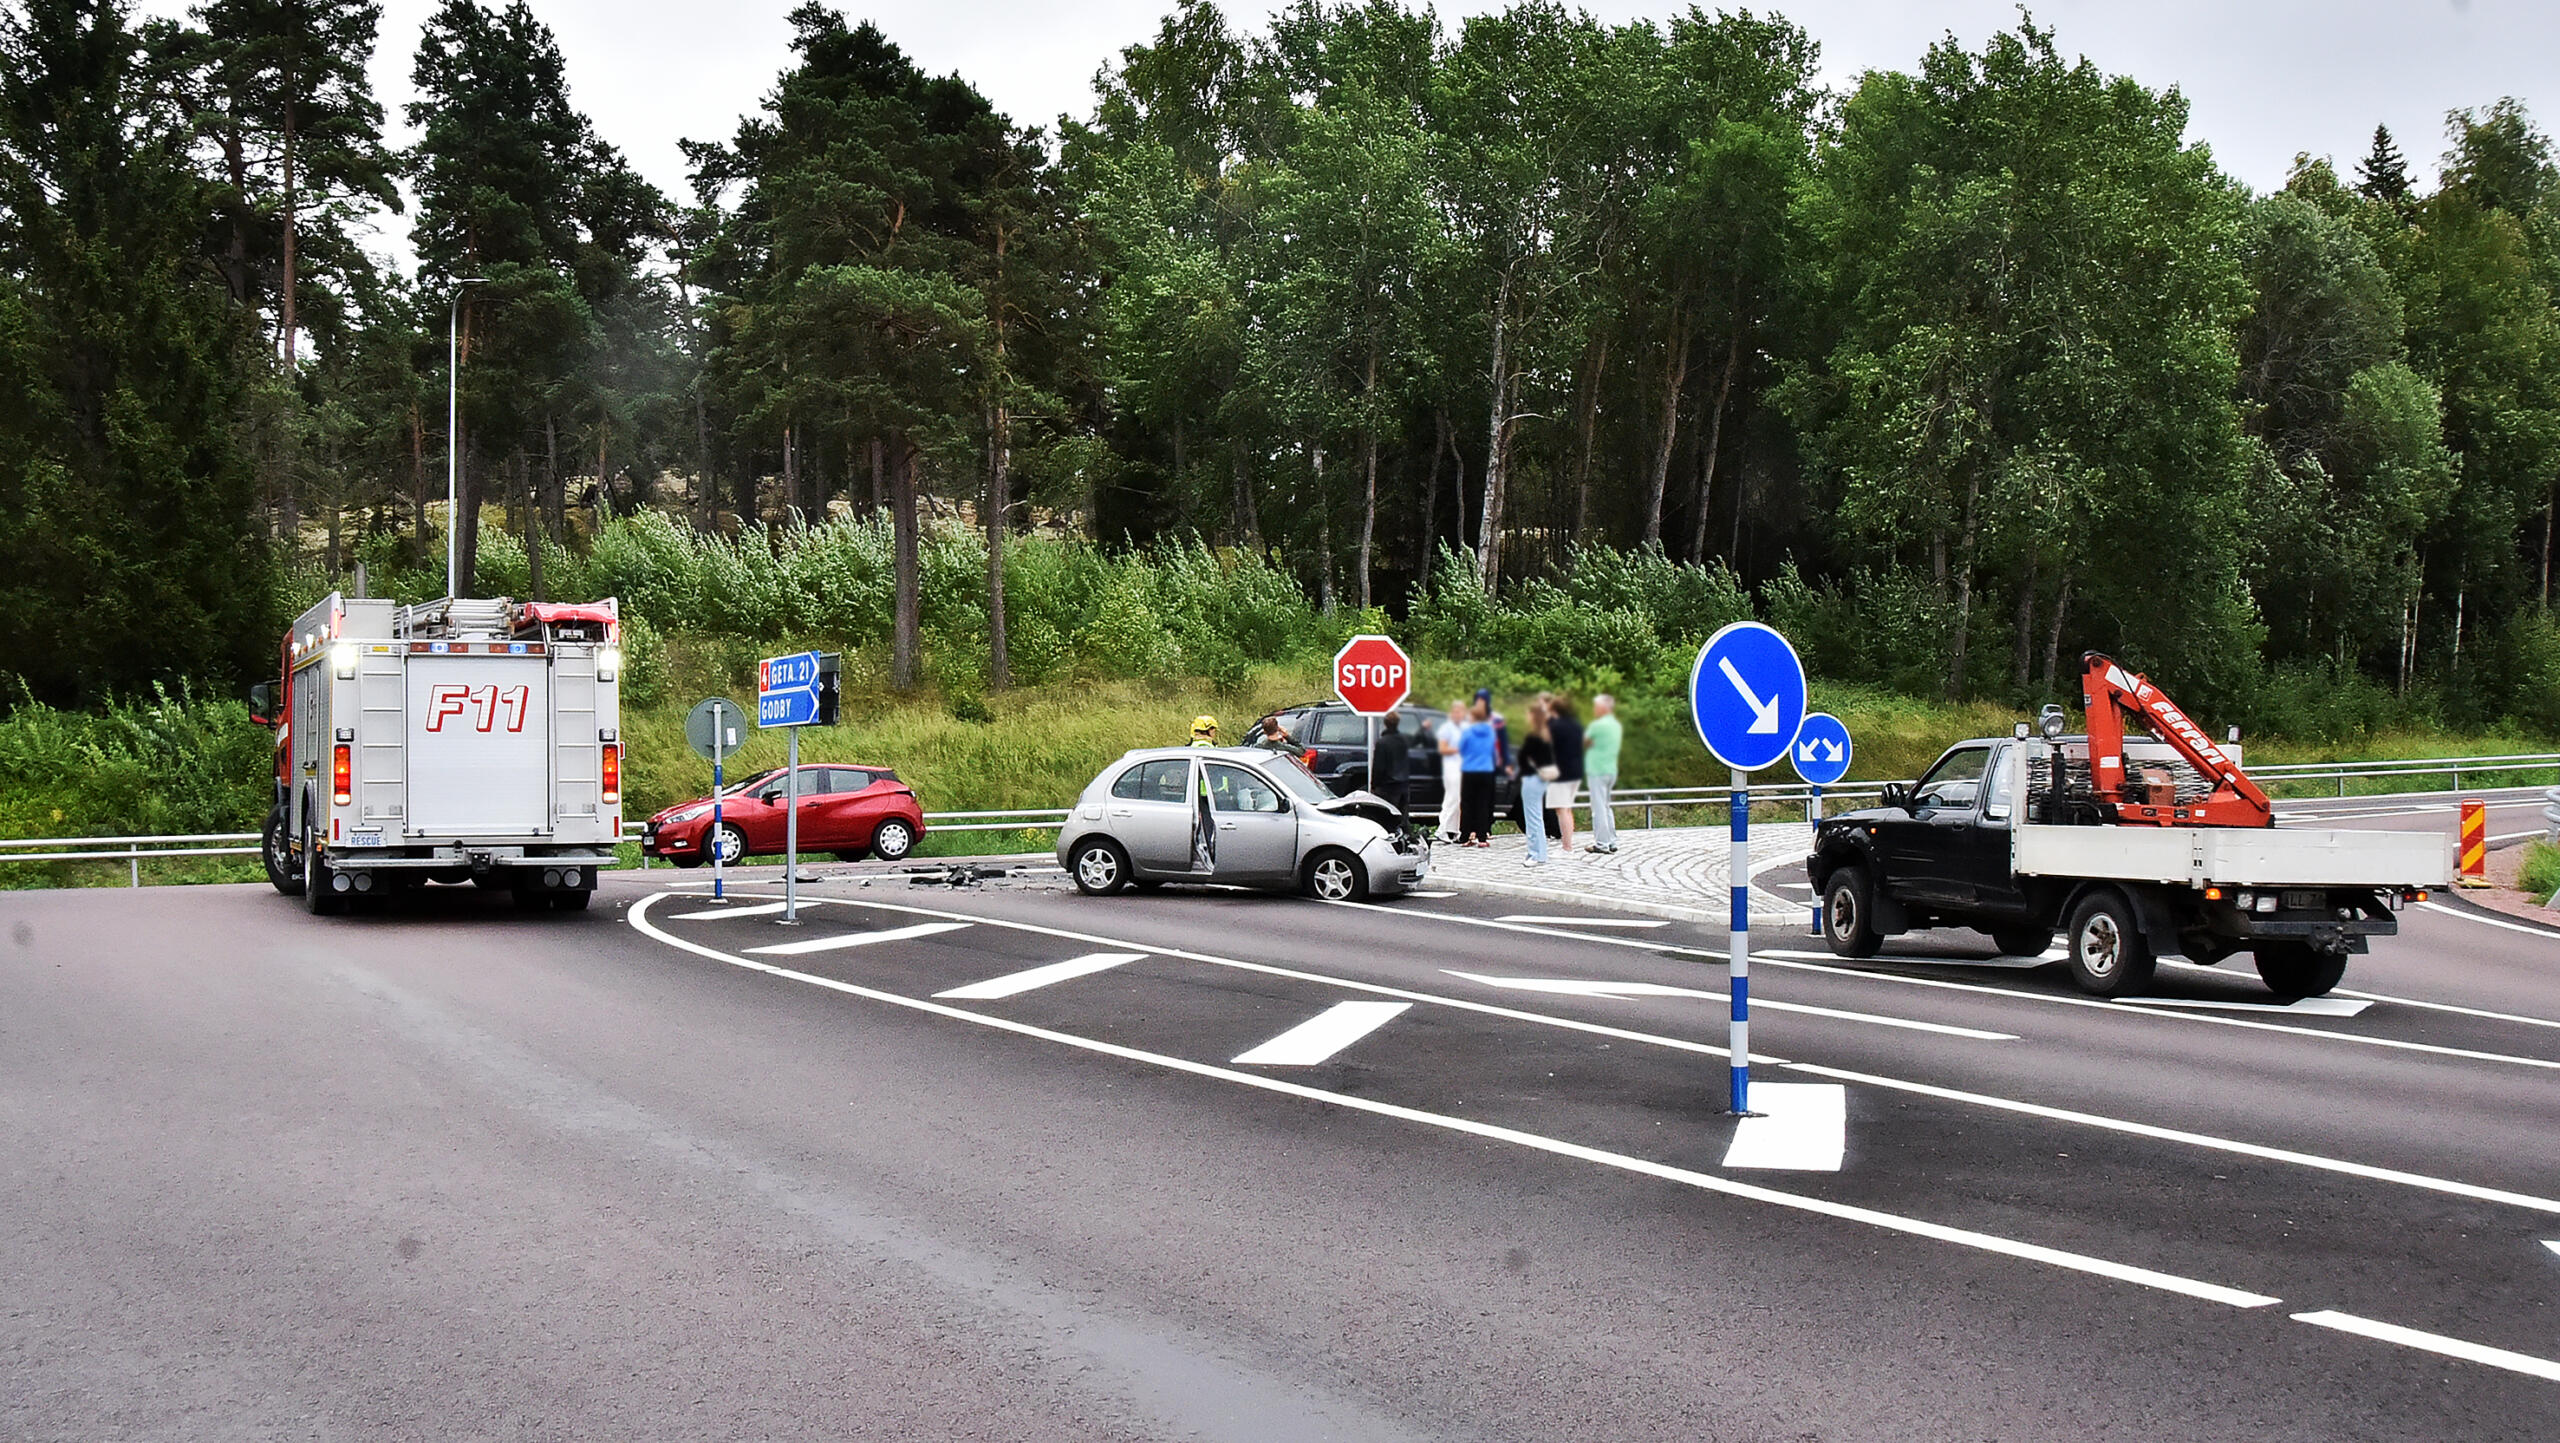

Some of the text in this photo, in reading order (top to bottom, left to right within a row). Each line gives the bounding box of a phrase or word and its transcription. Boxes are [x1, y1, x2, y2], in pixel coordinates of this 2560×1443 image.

[762, 660, 810, 686] 4 GETA 21
[1341, 664, 1403, 688] STOP
[425, 684, 530, 733] F11
[761, 698, 792, 719] GODBY
[351, 836, 381, 846] RESCUE
